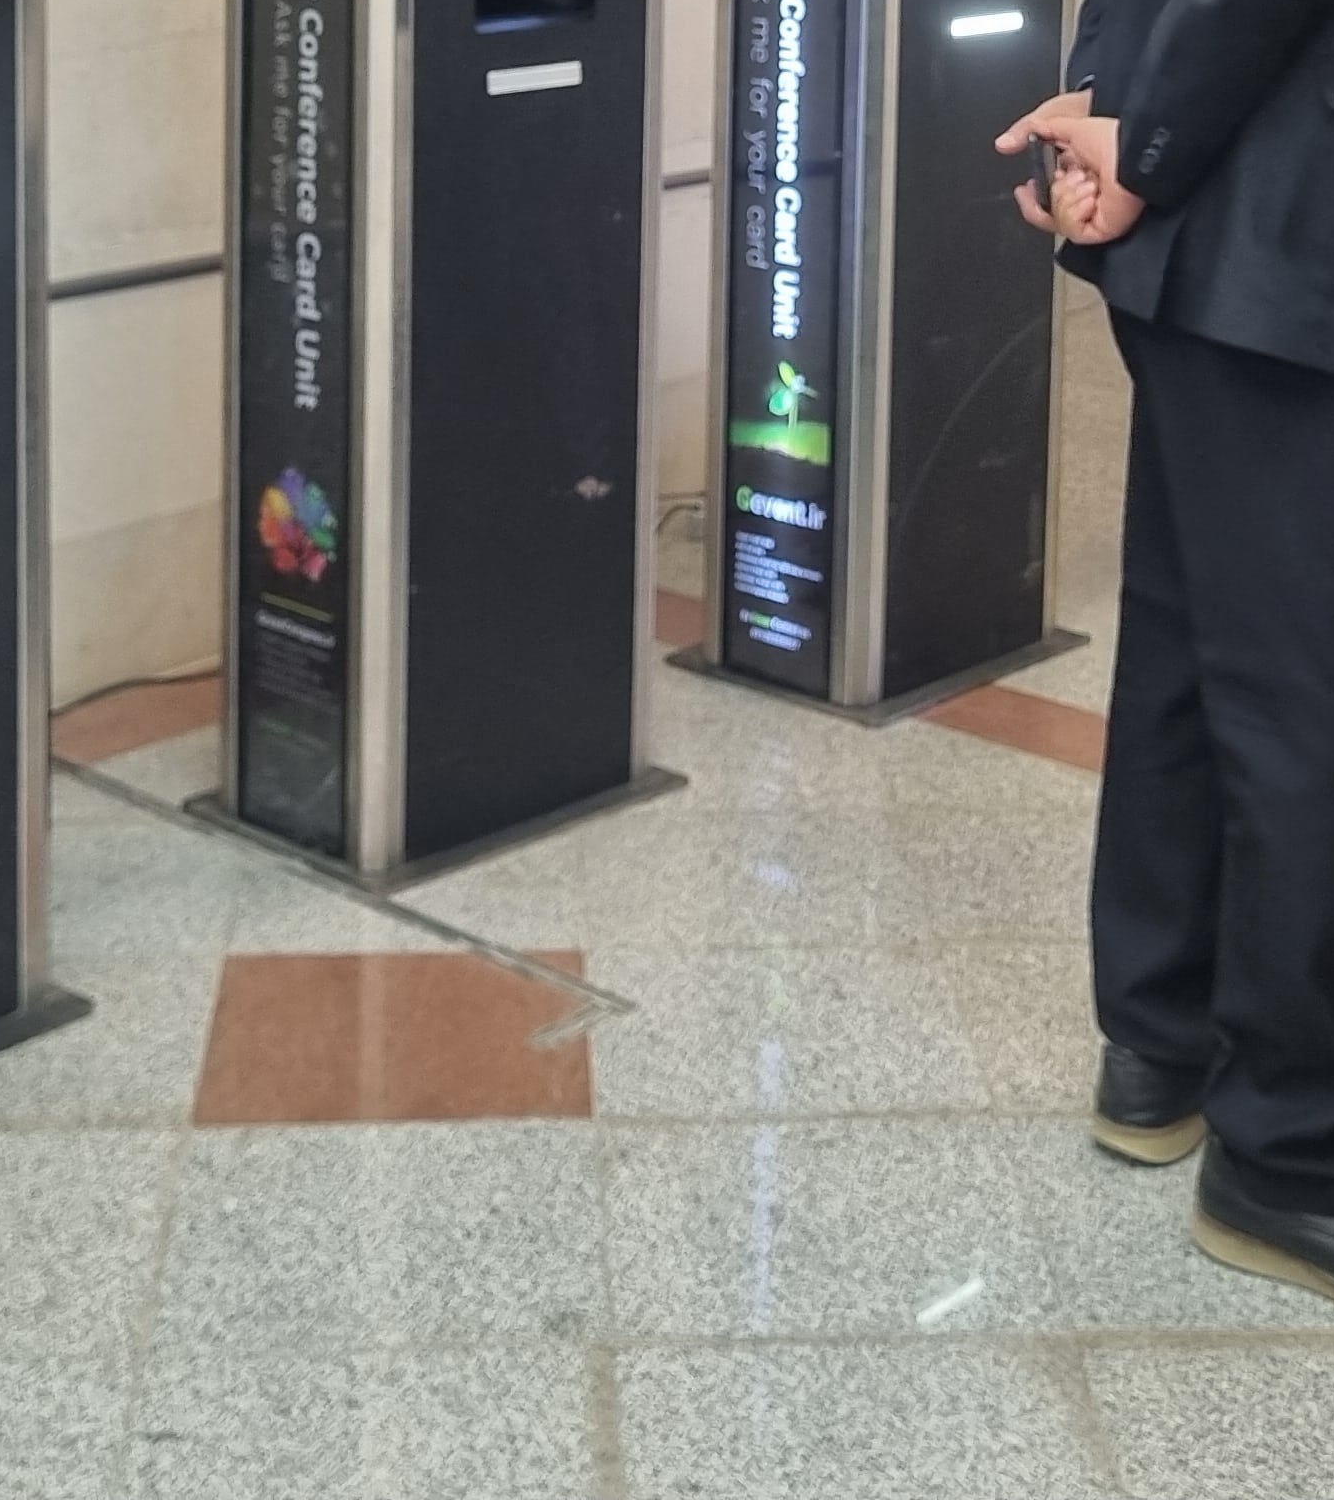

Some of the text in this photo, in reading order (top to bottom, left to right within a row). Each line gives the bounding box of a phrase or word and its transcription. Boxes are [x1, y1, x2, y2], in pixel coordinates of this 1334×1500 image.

[750, 16, 770, 64] me
[296, 8, 323, 225] Conference
[748, 77, 774, 118] for
[743, 129, 768, 195] your
[745, 204, 770, 270] card
[774, 186, 803, 267] Card
[295, 232, 322, 322] Card
[772, 269, 801, 340] Unit
[294, 328, 322, 412] Unit
